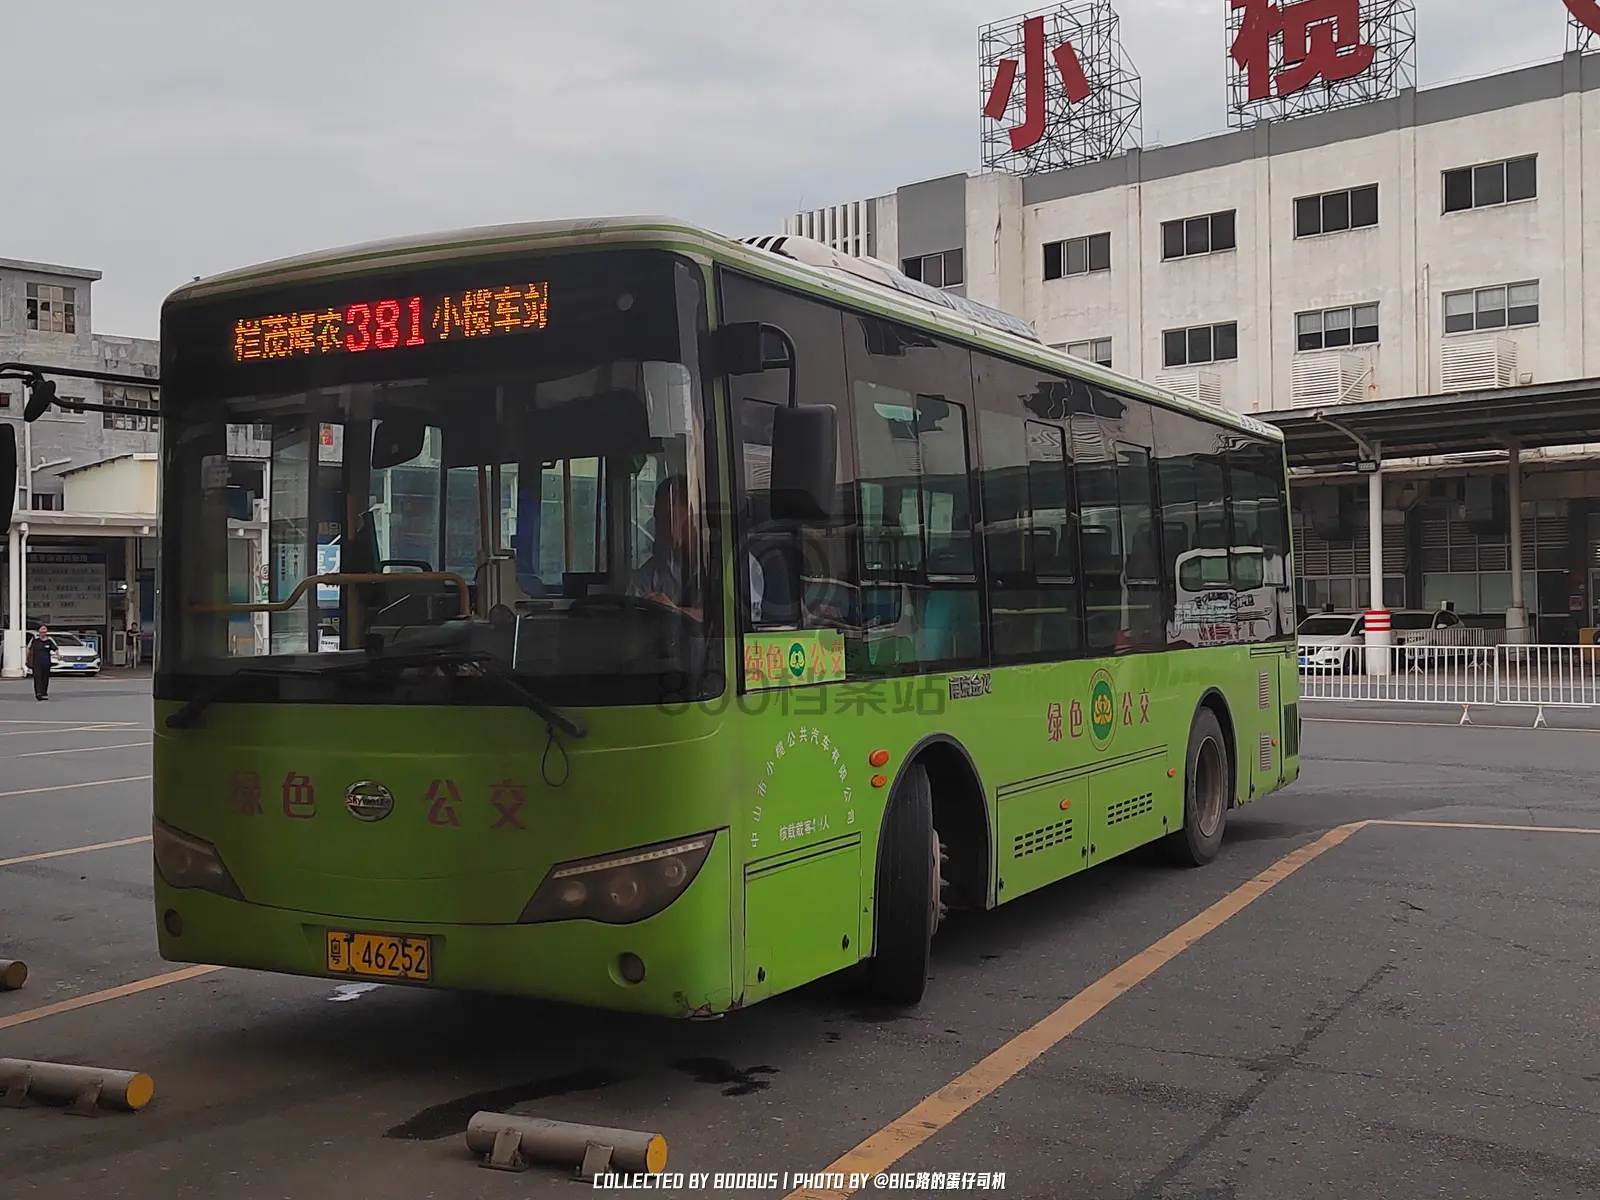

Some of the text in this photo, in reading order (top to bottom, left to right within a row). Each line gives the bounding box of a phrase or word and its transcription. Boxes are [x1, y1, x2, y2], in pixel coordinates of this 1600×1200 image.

[346, 296, 425, 353] 381
[744, 640, 844, 682] 绿色 公交
[1047, 688, 1150, 743] 绿色 公交
[228, 770, 530, 831] 绿色 公交
